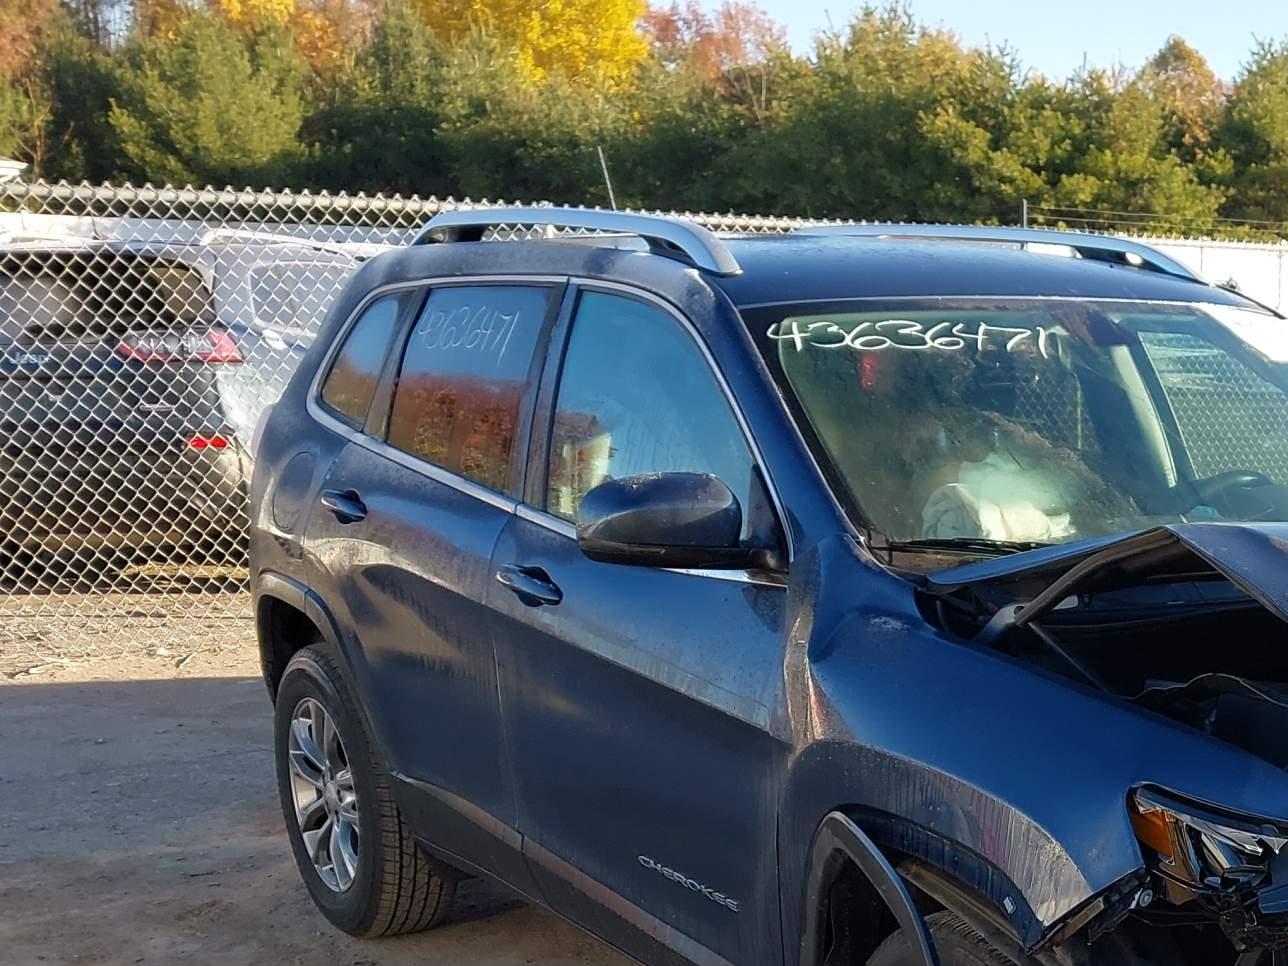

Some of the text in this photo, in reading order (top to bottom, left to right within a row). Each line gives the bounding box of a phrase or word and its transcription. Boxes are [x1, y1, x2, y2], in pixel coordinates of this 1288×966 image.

[417, 303, 520, 367] 43636471
[766, 320, 1049, 359] 43636471
[638, 855, 740, 912] CHEROKEE
